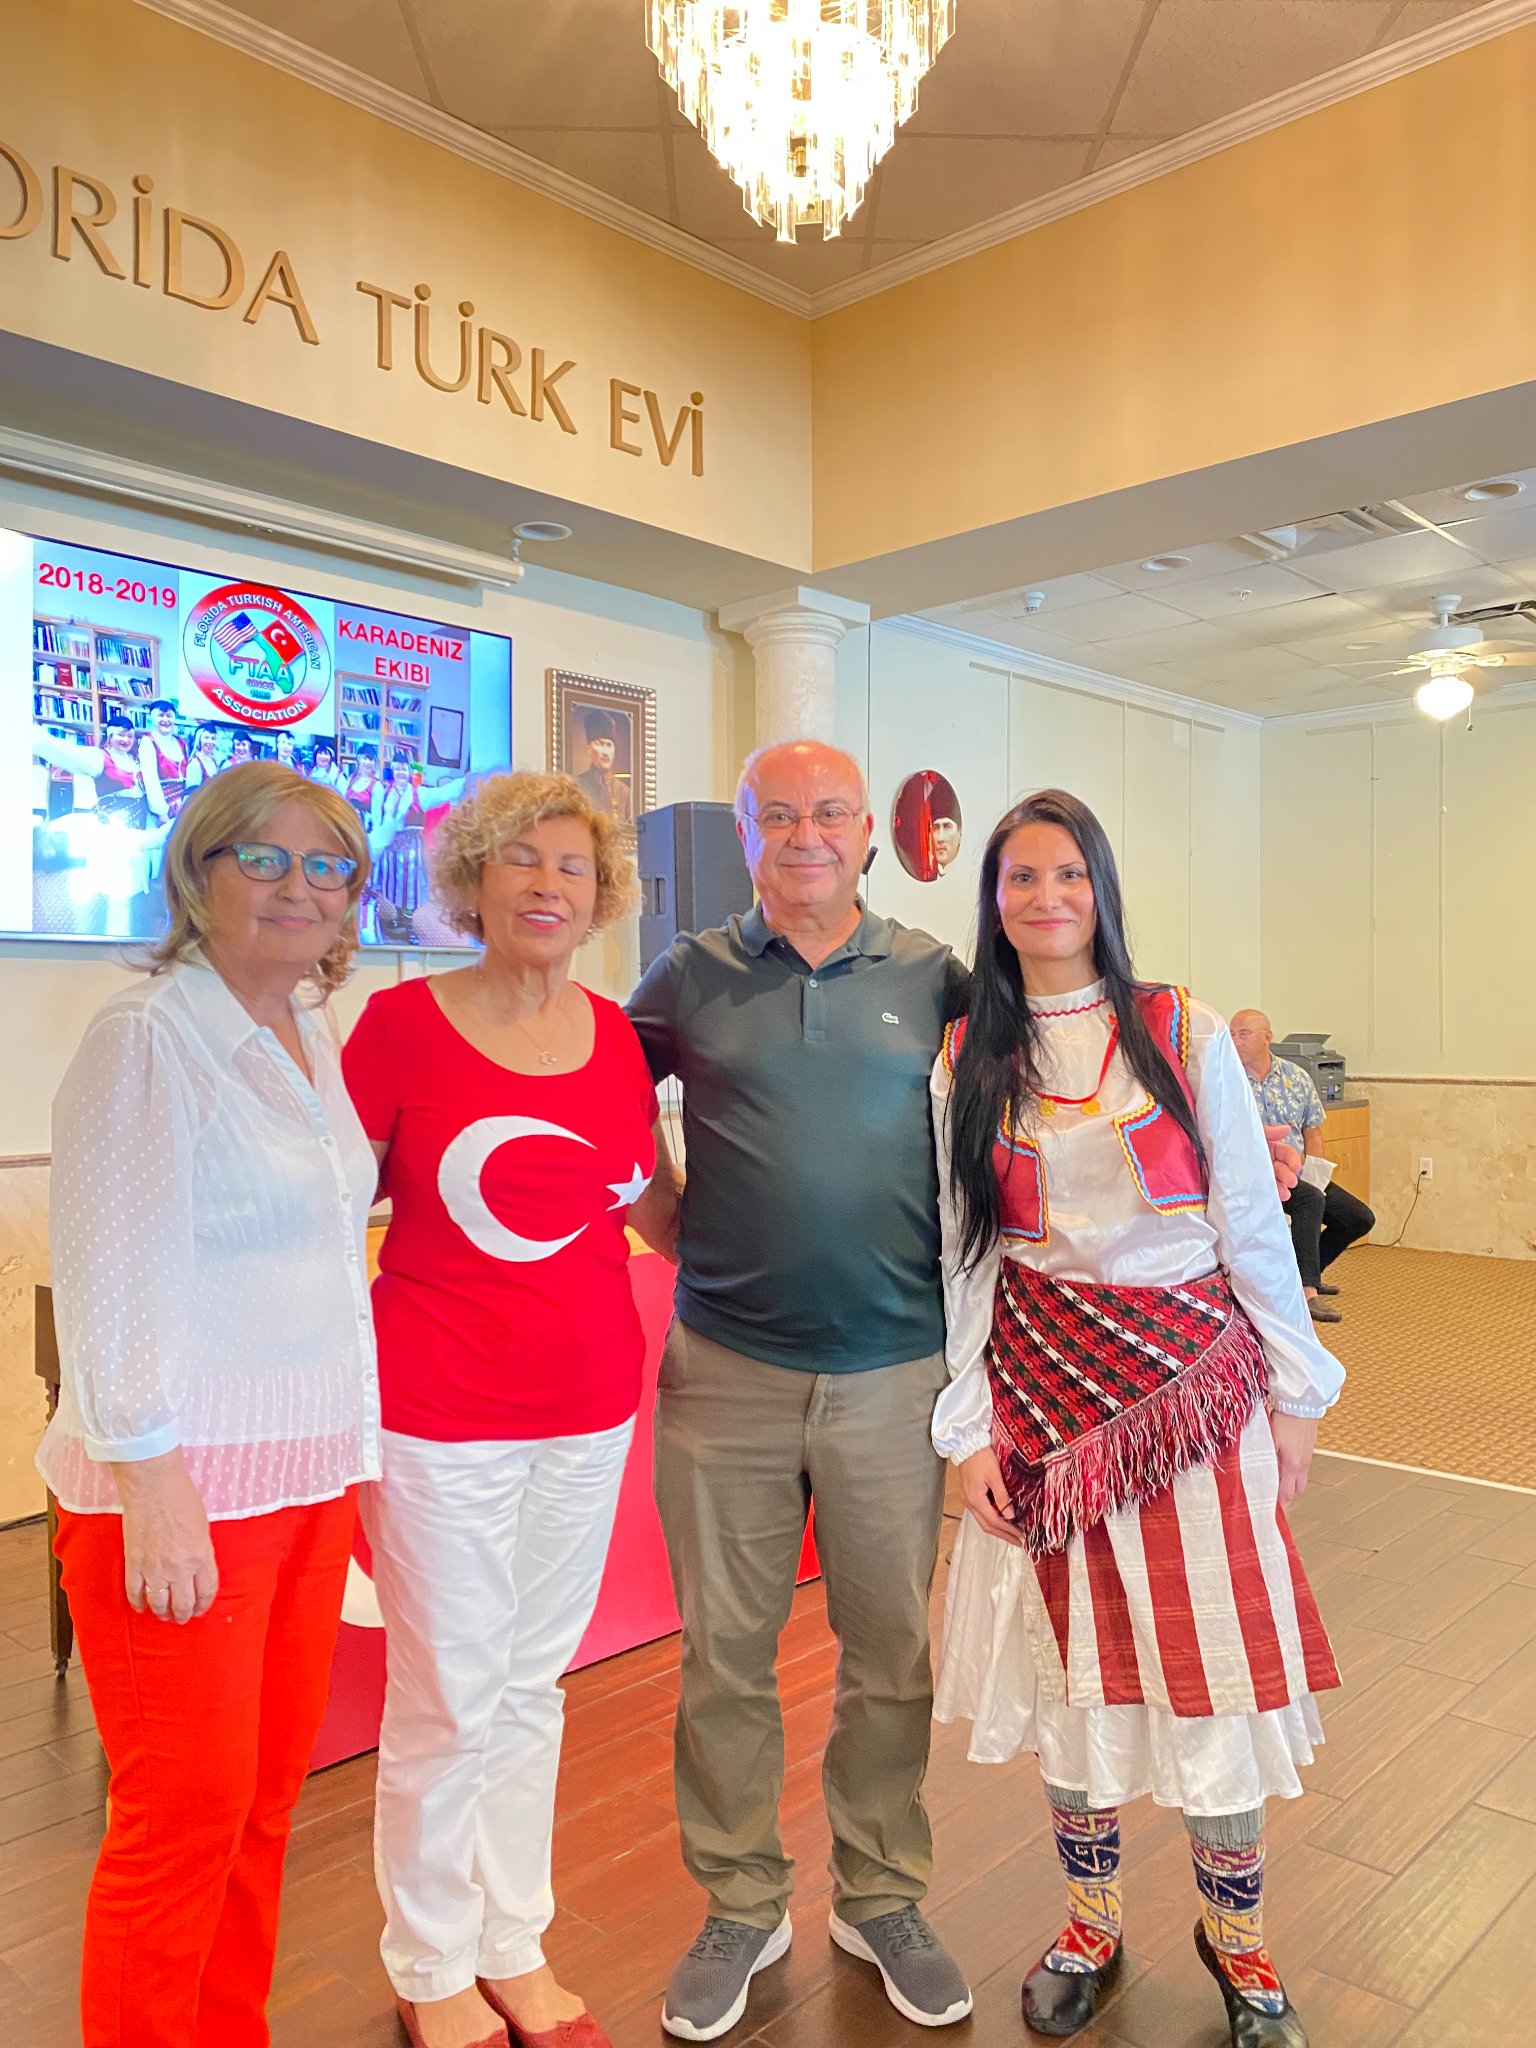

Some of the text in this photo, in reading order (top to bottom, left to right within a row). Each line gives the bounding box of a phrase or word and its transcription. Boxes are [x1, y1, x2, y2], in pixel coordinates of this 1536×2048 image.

[356, 280, 578, 435] TÜRK
[609, 378, 704, 477] EVİ
[38, 563, 176, 608] 2018-2019
[194, 594, 320, 669] FLORIDA TURKISH AMERICAN
[338, 618, 464, 661] KARADENIZ
[229, 654, 292, 682] FTAA
[374, 655, 431, 685] EKIBI
[212, 687, 307, 720] ASSOCIATION
